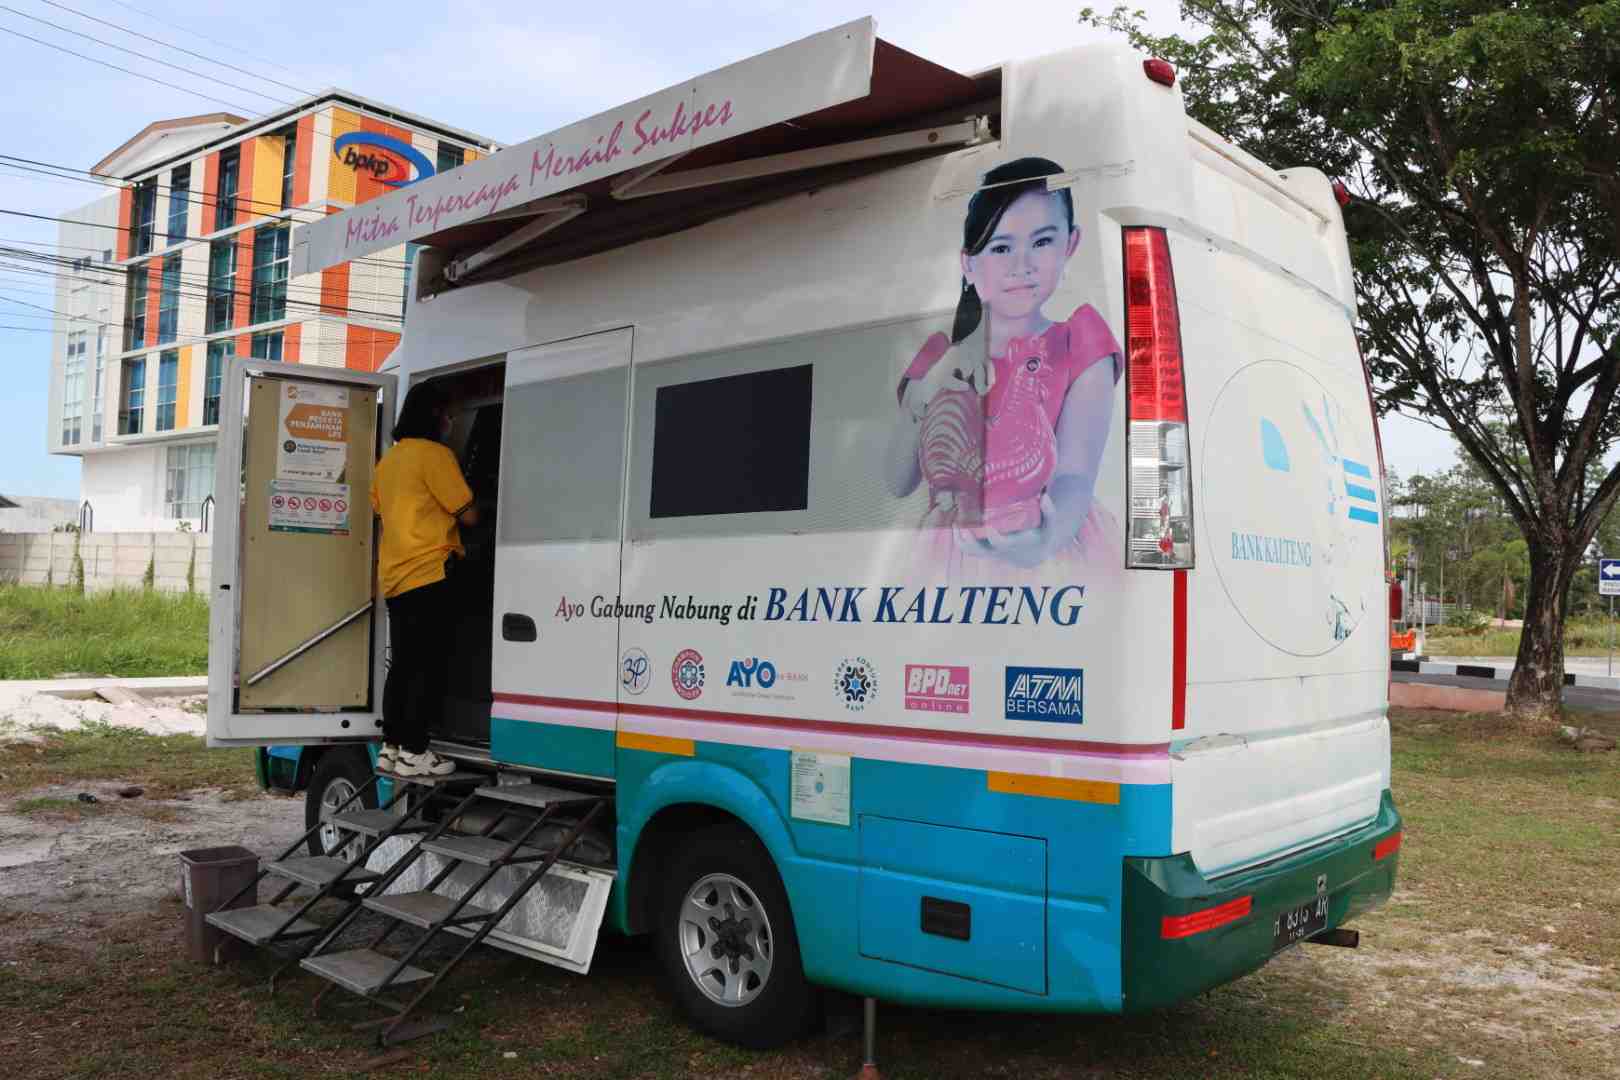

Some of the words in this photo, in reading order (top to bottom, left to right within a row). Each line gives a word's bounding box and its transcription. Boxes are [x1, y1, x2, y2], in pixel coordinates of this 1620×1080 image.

[343, 147, 389, 177] bpkp
[345, 214, 400, 249] Mitra
[407, 174, 520, 231] Terpercaya
[529, 121, 624, 187] Meraih
[633, 97, 735, 155] Sukses
[554, 597, 585, 621] Ayo
[590, 595, 655, 623] Gabung
[659, 595, 733, 625] Nabung
[737, 594, 758, 620] di
[764, 587, 866, 624] BANK
[873, 585, 1087, 626] KALTENG
[725, 656, 777, 689] AYO
[907, 666, 951, 697] BPD
[1008, 673, 1082, 701] ATM
[910, 701, 964, 713] online
[1007, 699, 1082, 717] BERSAMA
